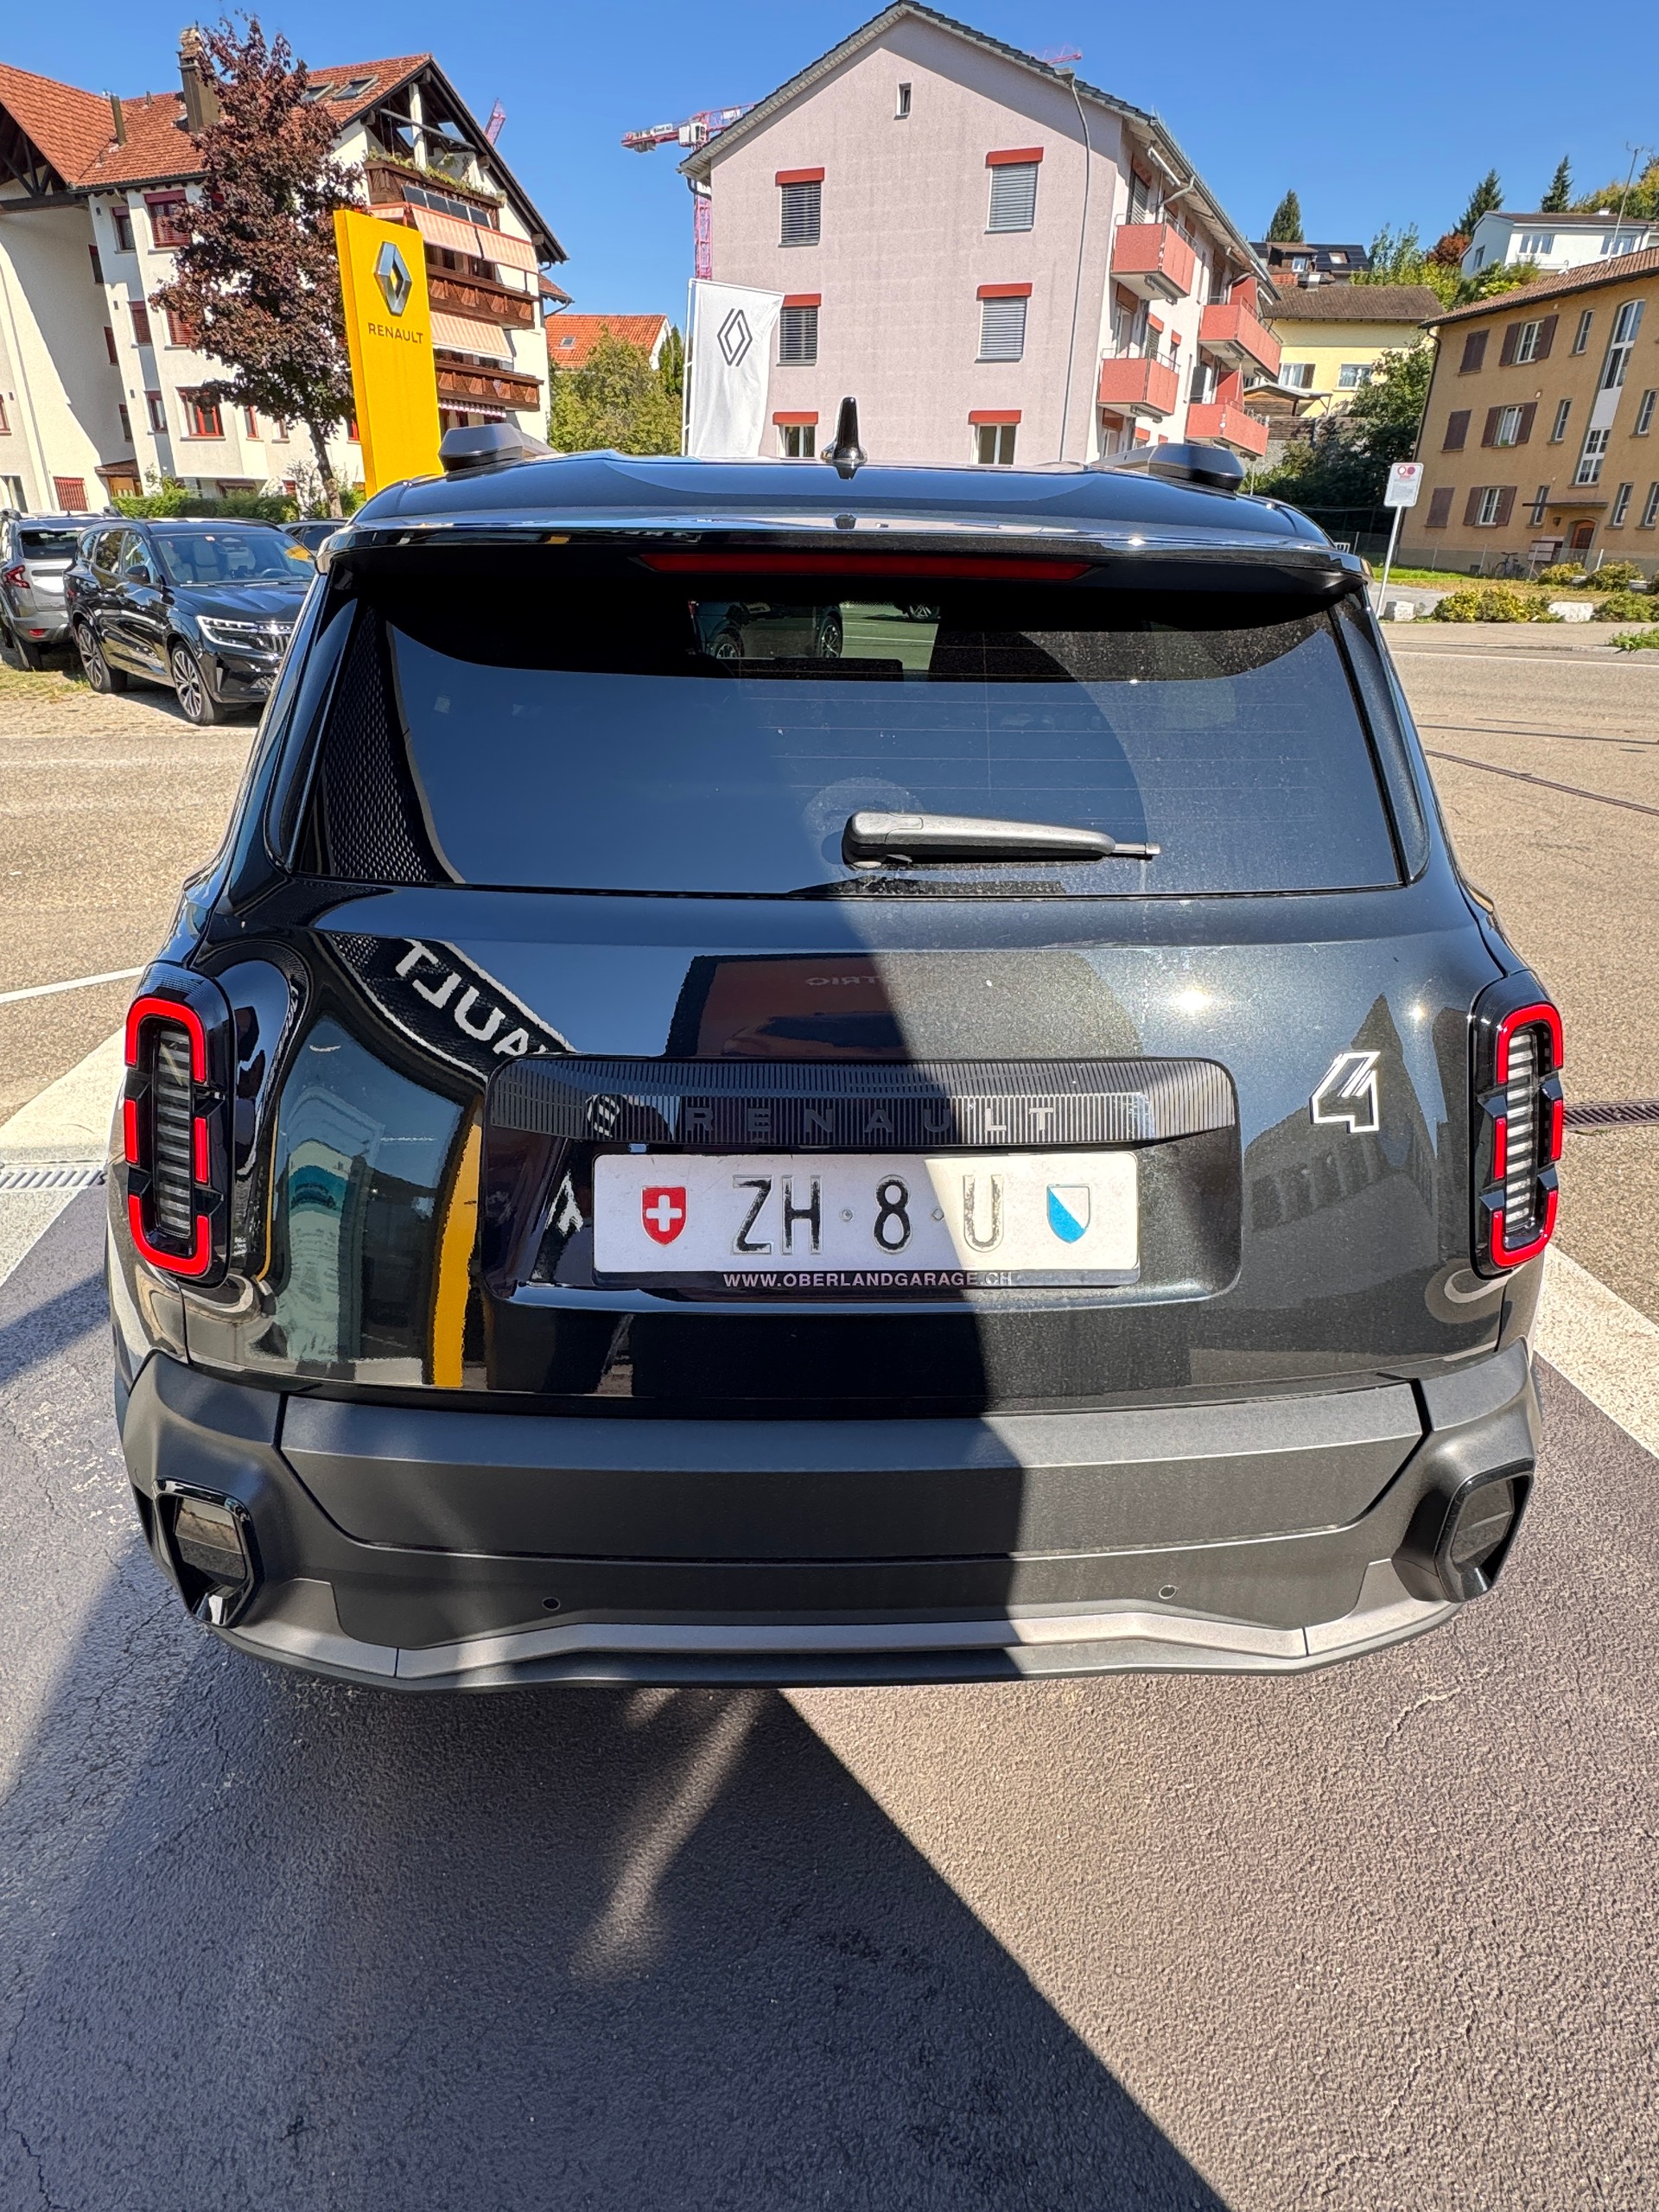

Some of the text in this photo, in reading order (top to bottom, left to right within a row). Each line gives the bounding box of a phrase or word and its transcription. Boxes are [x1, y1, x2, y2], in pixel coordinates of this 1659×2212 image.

[367, 321, 423, 344] RENAULT
[1308, 1050, 1381, 1134] 4
[685, 1106, 1055, 1134] RENAULT
[732, 1173, 1005, 1255] ZH 8 U
[723, 1272, 1012, 1287] WWW.OBERLANDGARAGE.CH
